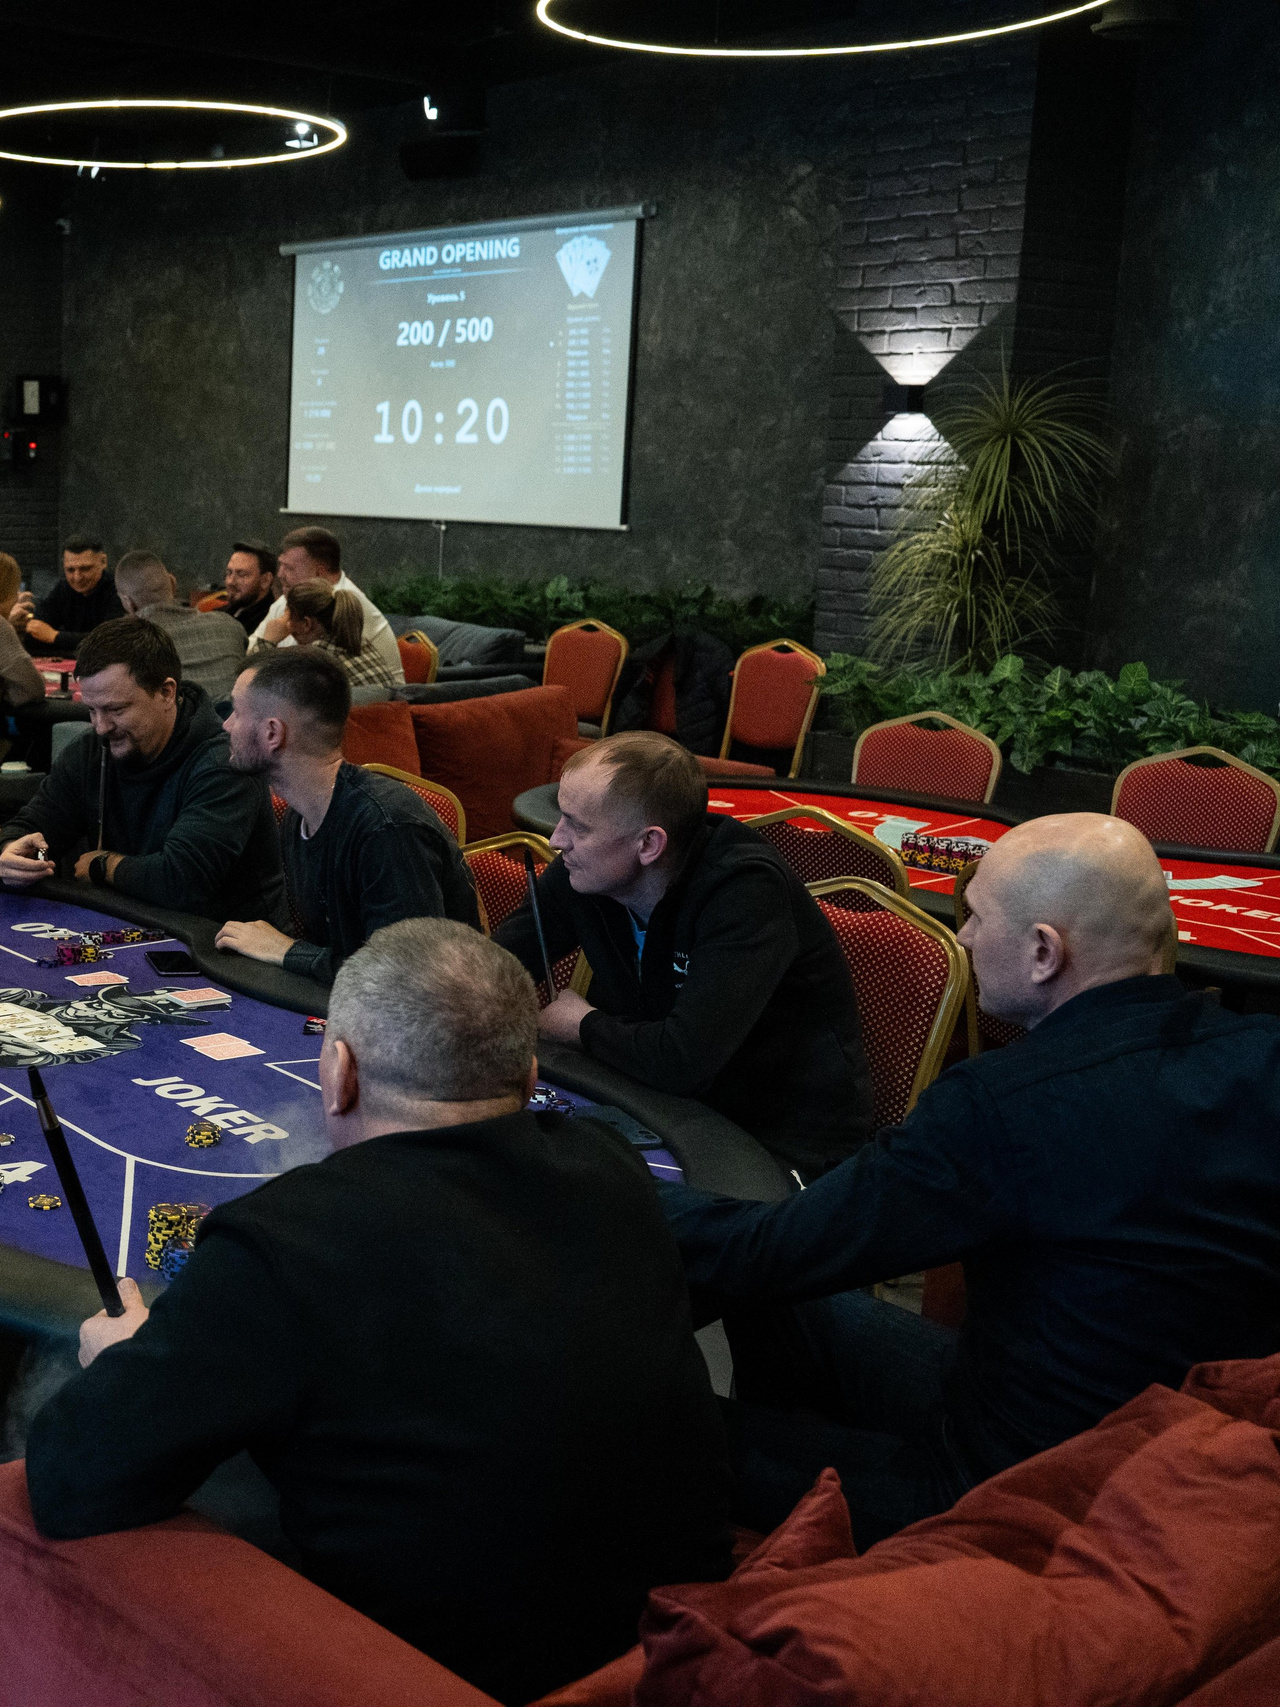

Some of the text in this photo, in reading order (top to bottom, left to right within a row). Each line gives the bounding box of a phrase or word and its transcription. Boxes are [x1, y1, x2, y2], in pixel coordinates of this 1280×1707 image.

[379, 237, 520, 270] GRAND OPENING
[396, 320, 435, 347] 200
[455, 316, 494, 343] 500
[372, 397, 511, 446] 10:20
[1169, 895, 1280, 922] OKE
[130, 1075, 291, 1146] JOKER
